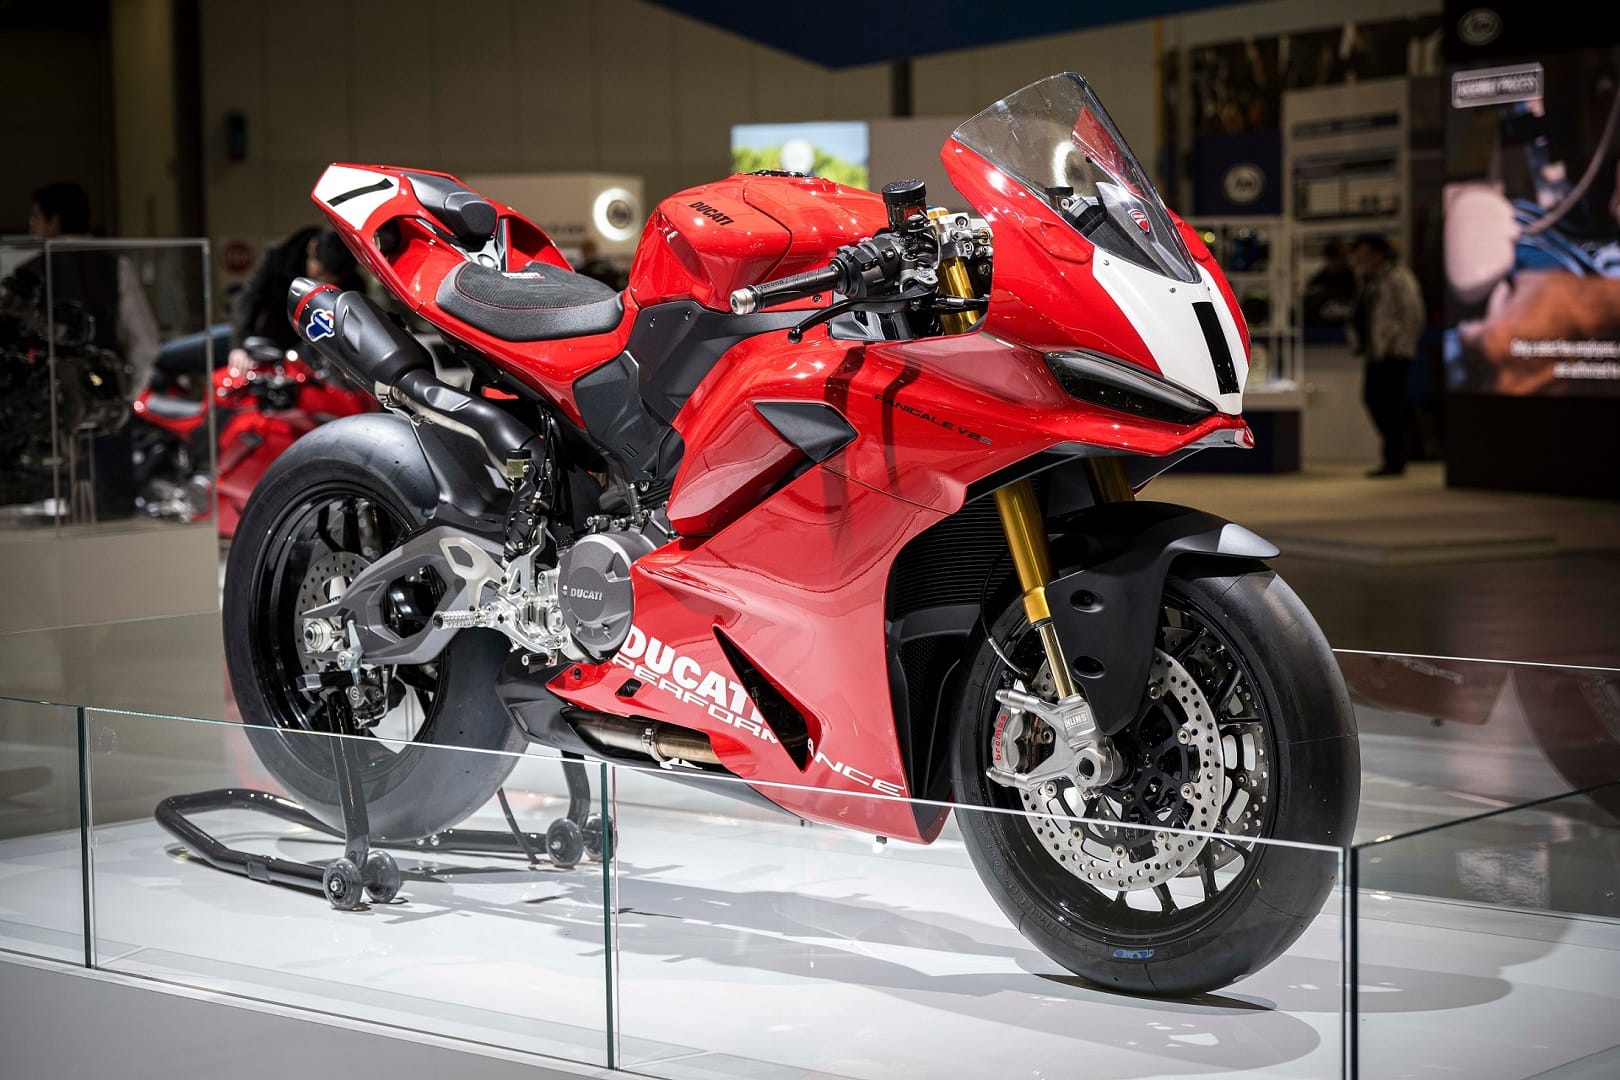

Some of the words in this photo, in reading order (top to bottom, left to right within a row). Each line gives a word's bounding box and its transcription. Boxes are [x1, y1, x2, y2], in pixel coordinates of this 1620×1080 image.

[688, 201, 735, 226] DUCATI
[569, 587, 603, 601] DUCATI
[1064, 713, 1088, 730] HLINS
